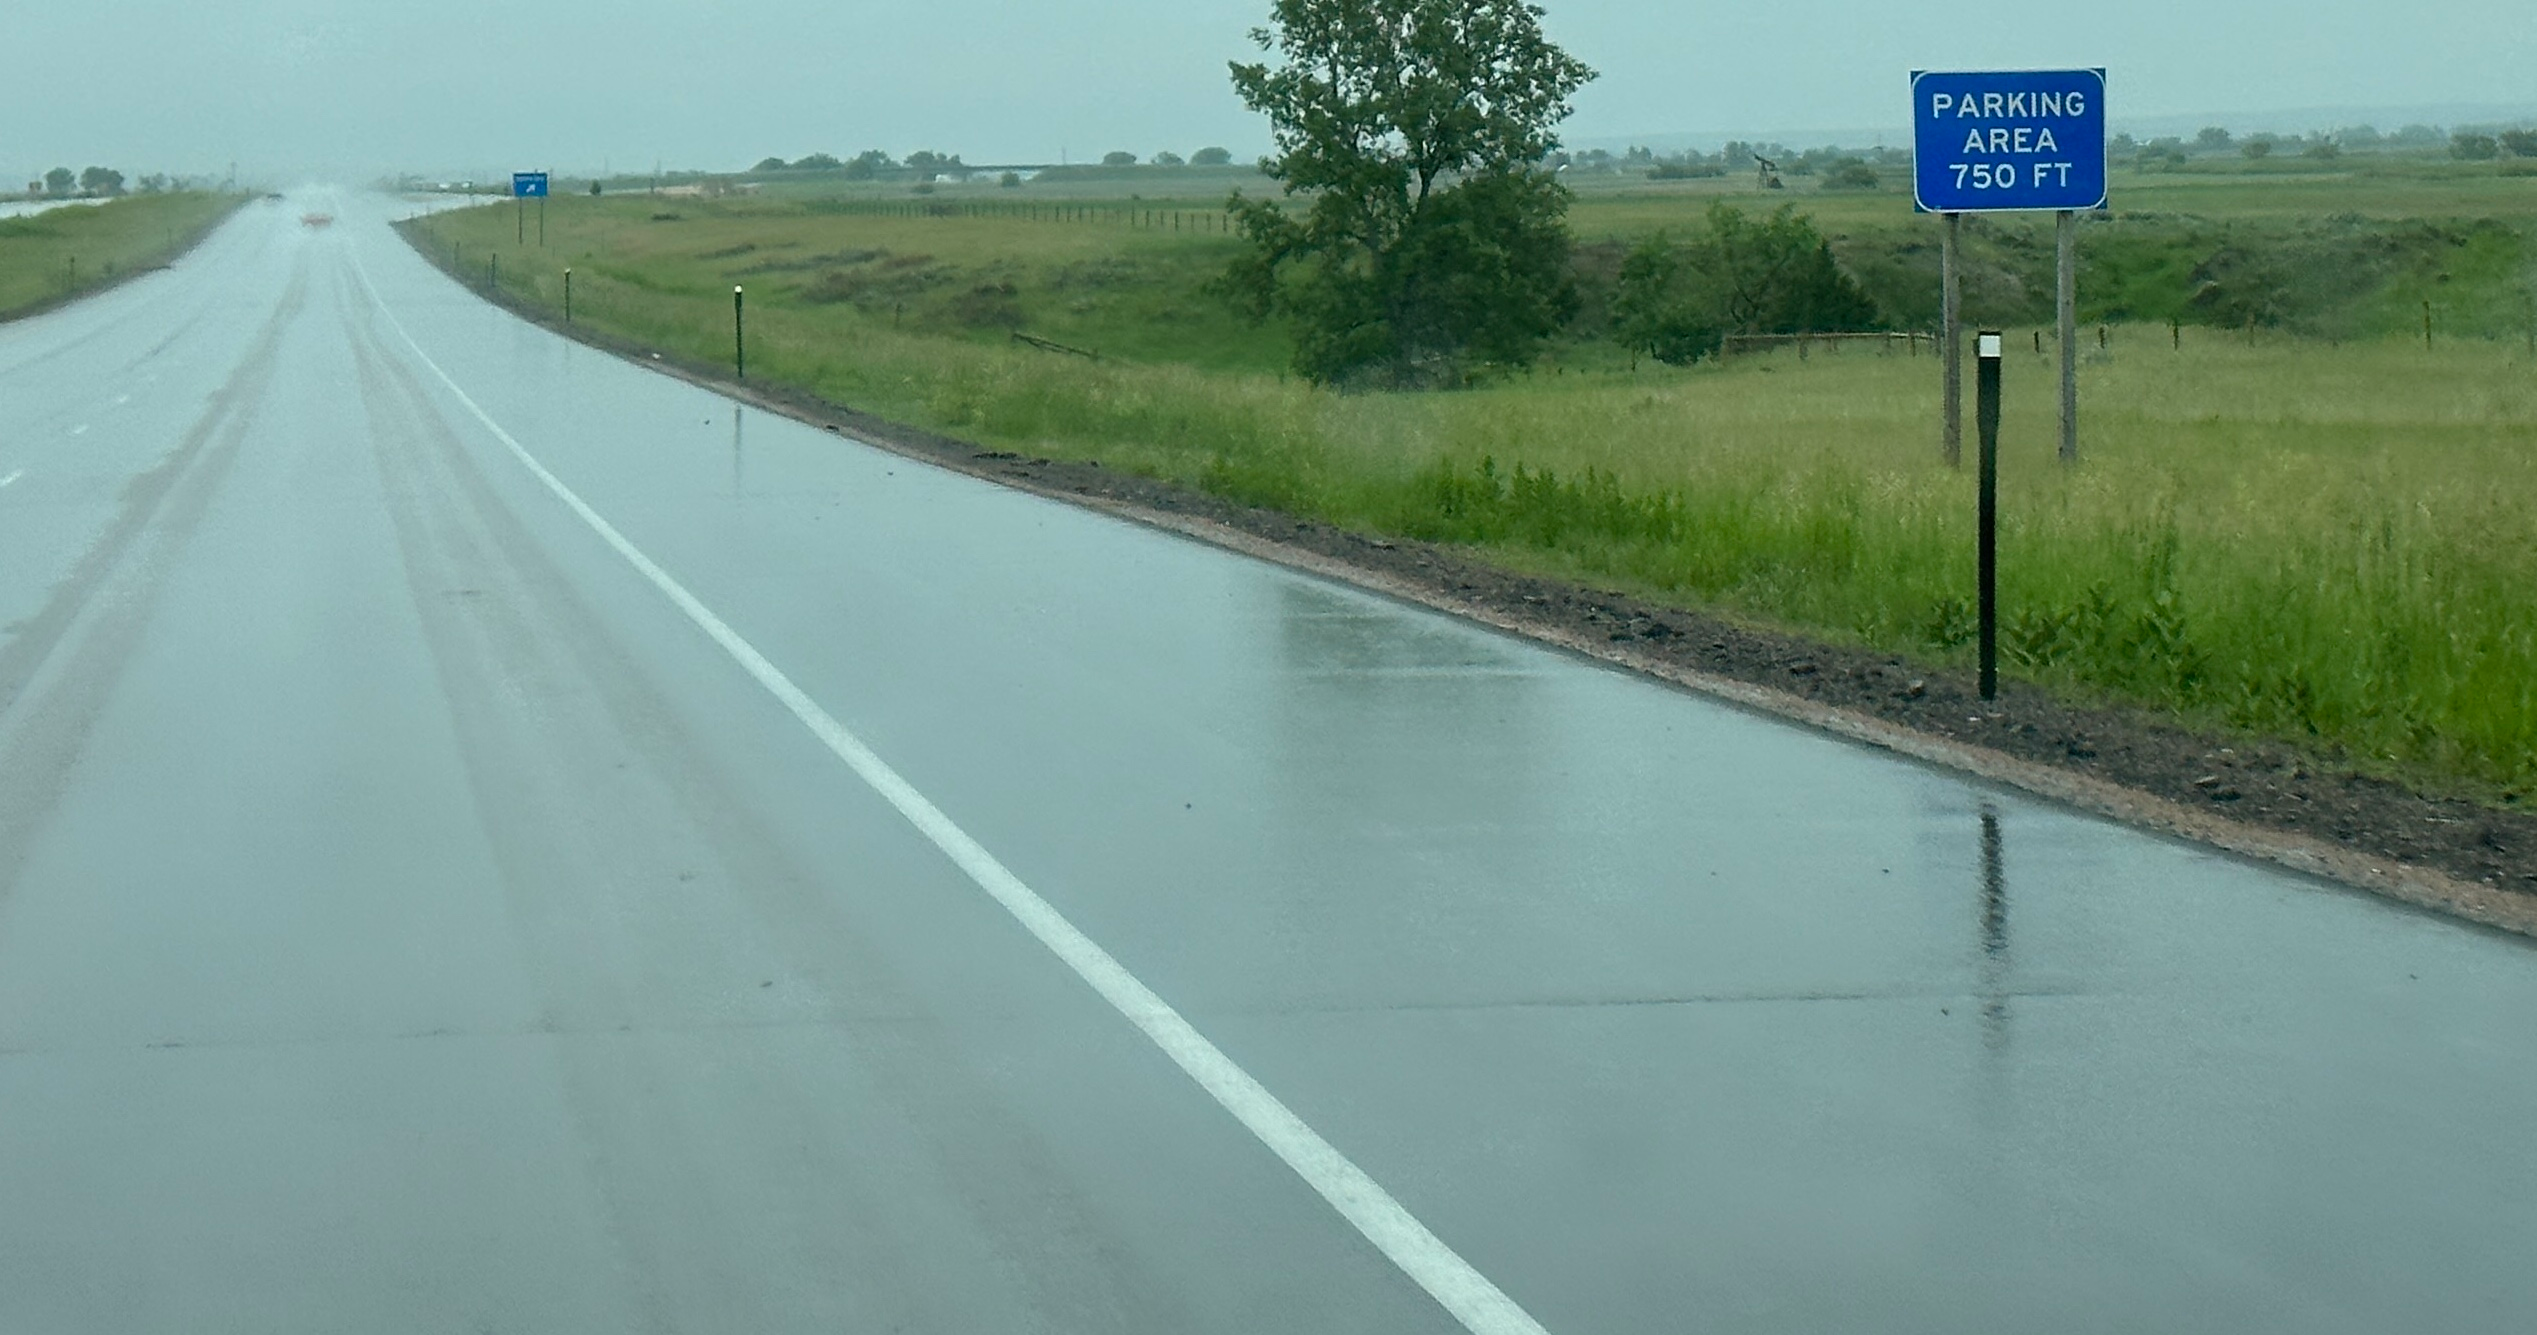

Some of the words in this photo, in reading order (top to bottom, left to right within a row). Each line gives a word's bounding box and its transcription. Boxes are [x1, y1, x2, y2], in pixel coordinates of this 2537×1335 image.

[1932, 92, 2085, 118] PARKING
[1962, 127, 2058, 154] AREA
[1949, 163, 2016, 189] 750
[2033, 162, 2073, 188] FT
